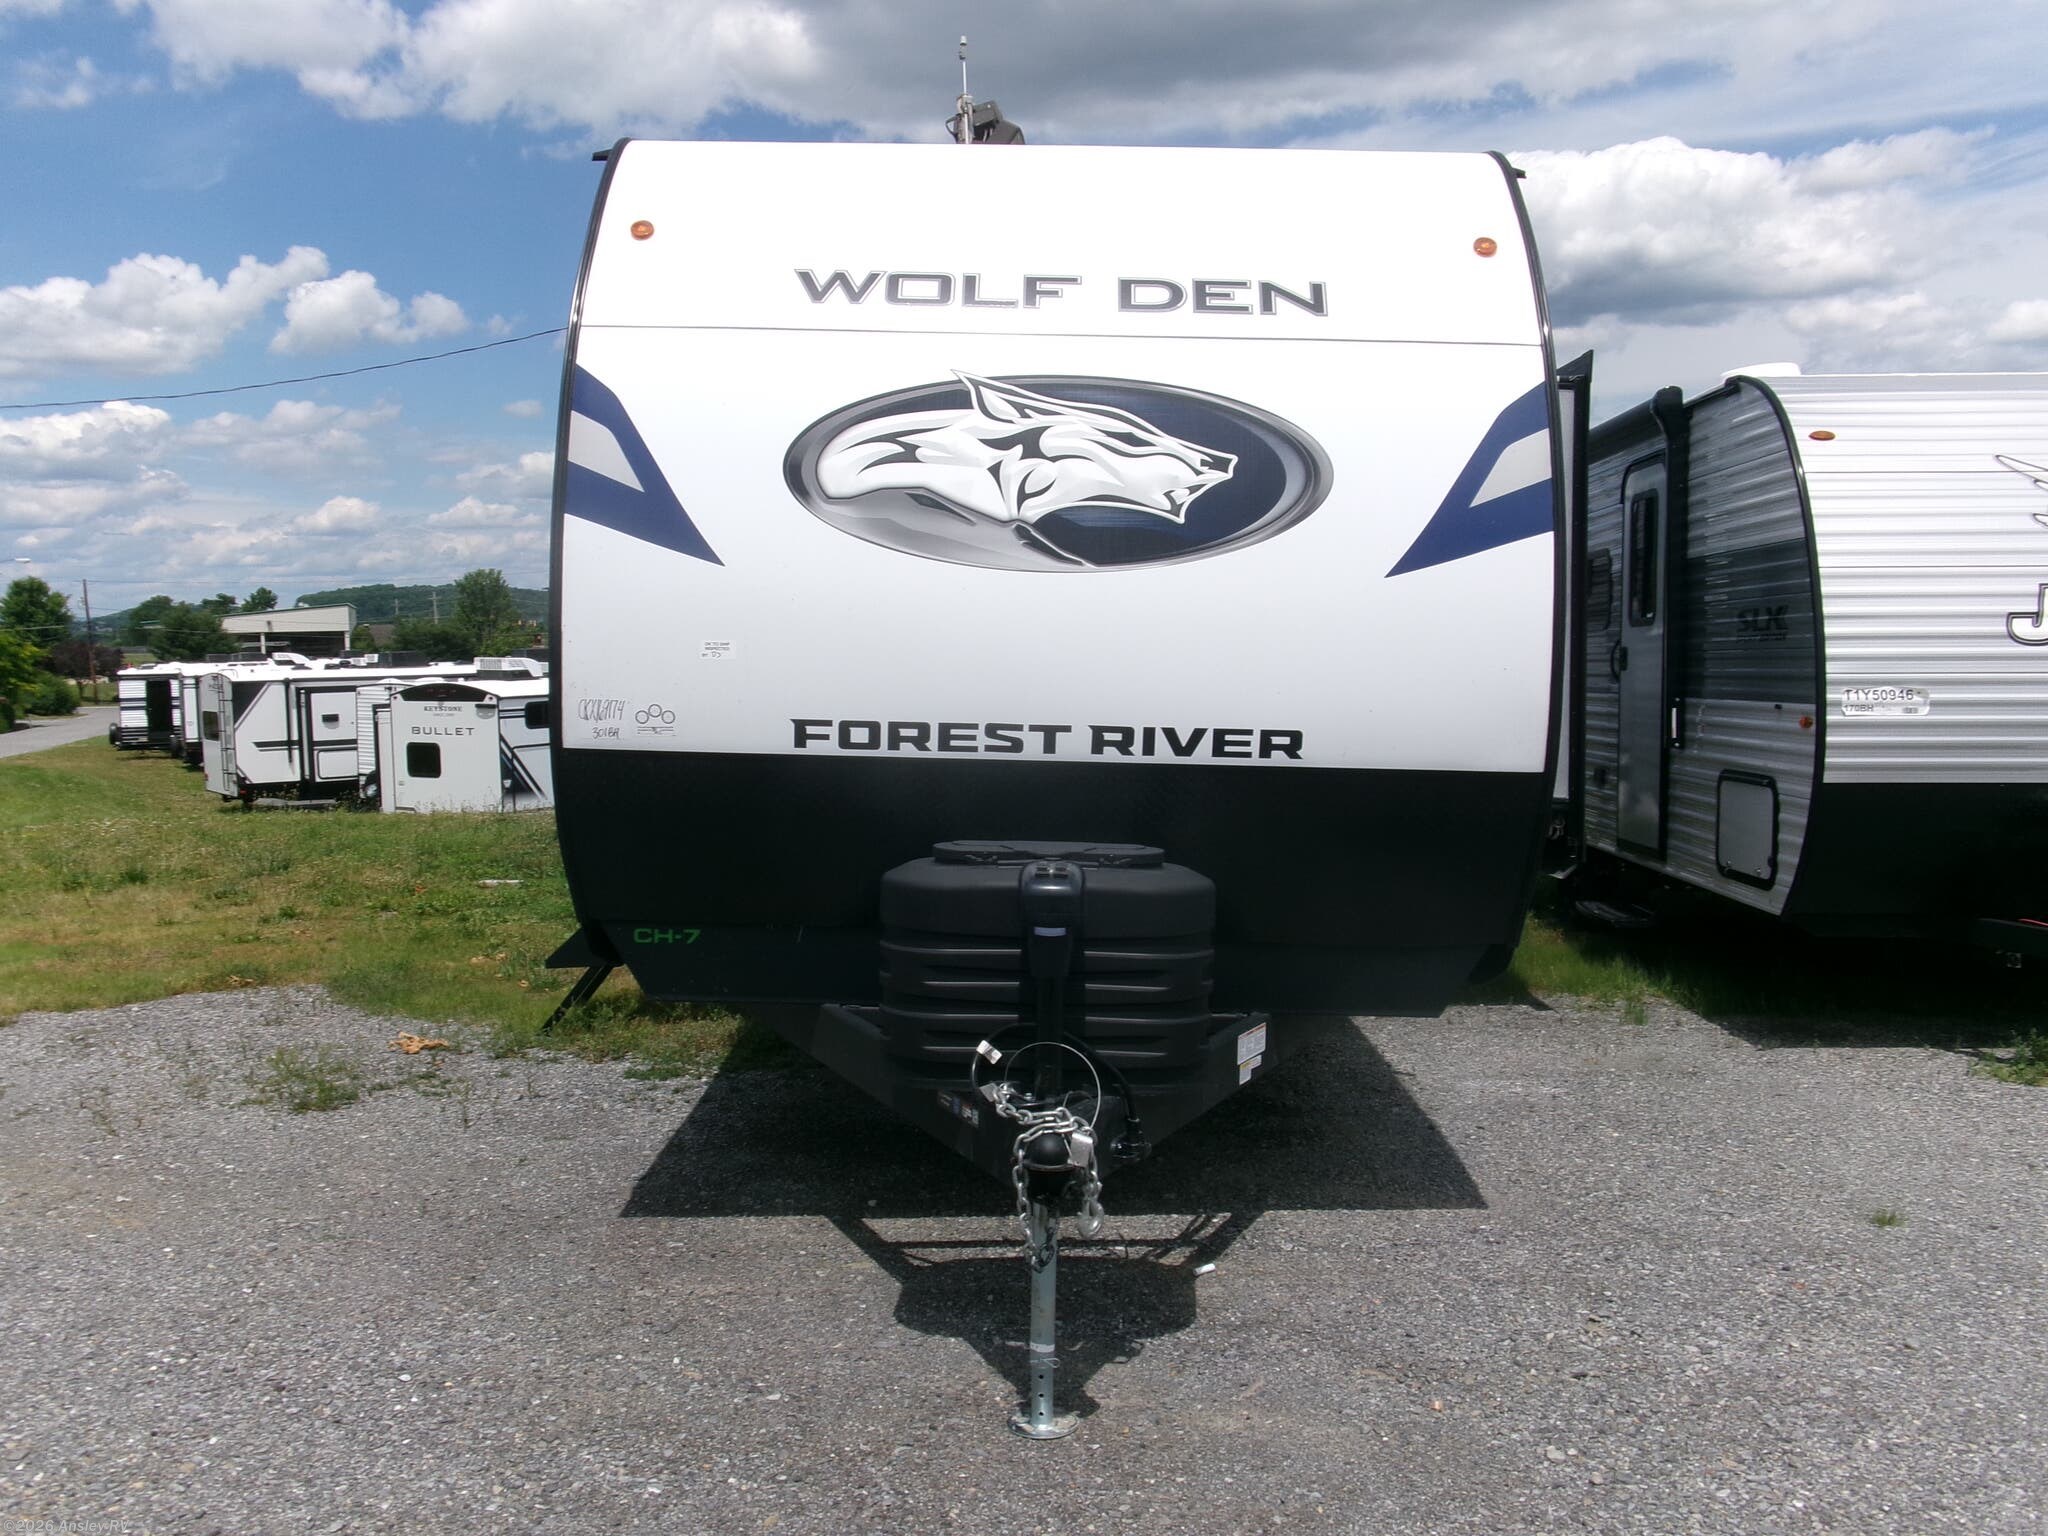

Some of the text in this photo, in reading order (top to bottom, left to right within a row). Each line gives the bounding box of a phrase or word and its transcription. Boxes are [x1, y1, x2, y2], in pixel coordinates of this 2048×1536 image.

[794, 268, 1328, 317] WOLF DEN
[1844, 688, 1914, 701] T1Y50946
[411, 726, 475, 736] BULLET
[789, 718, 1305, 760] FOREST RIVER
[633, 928, 701, 944] CH-7
